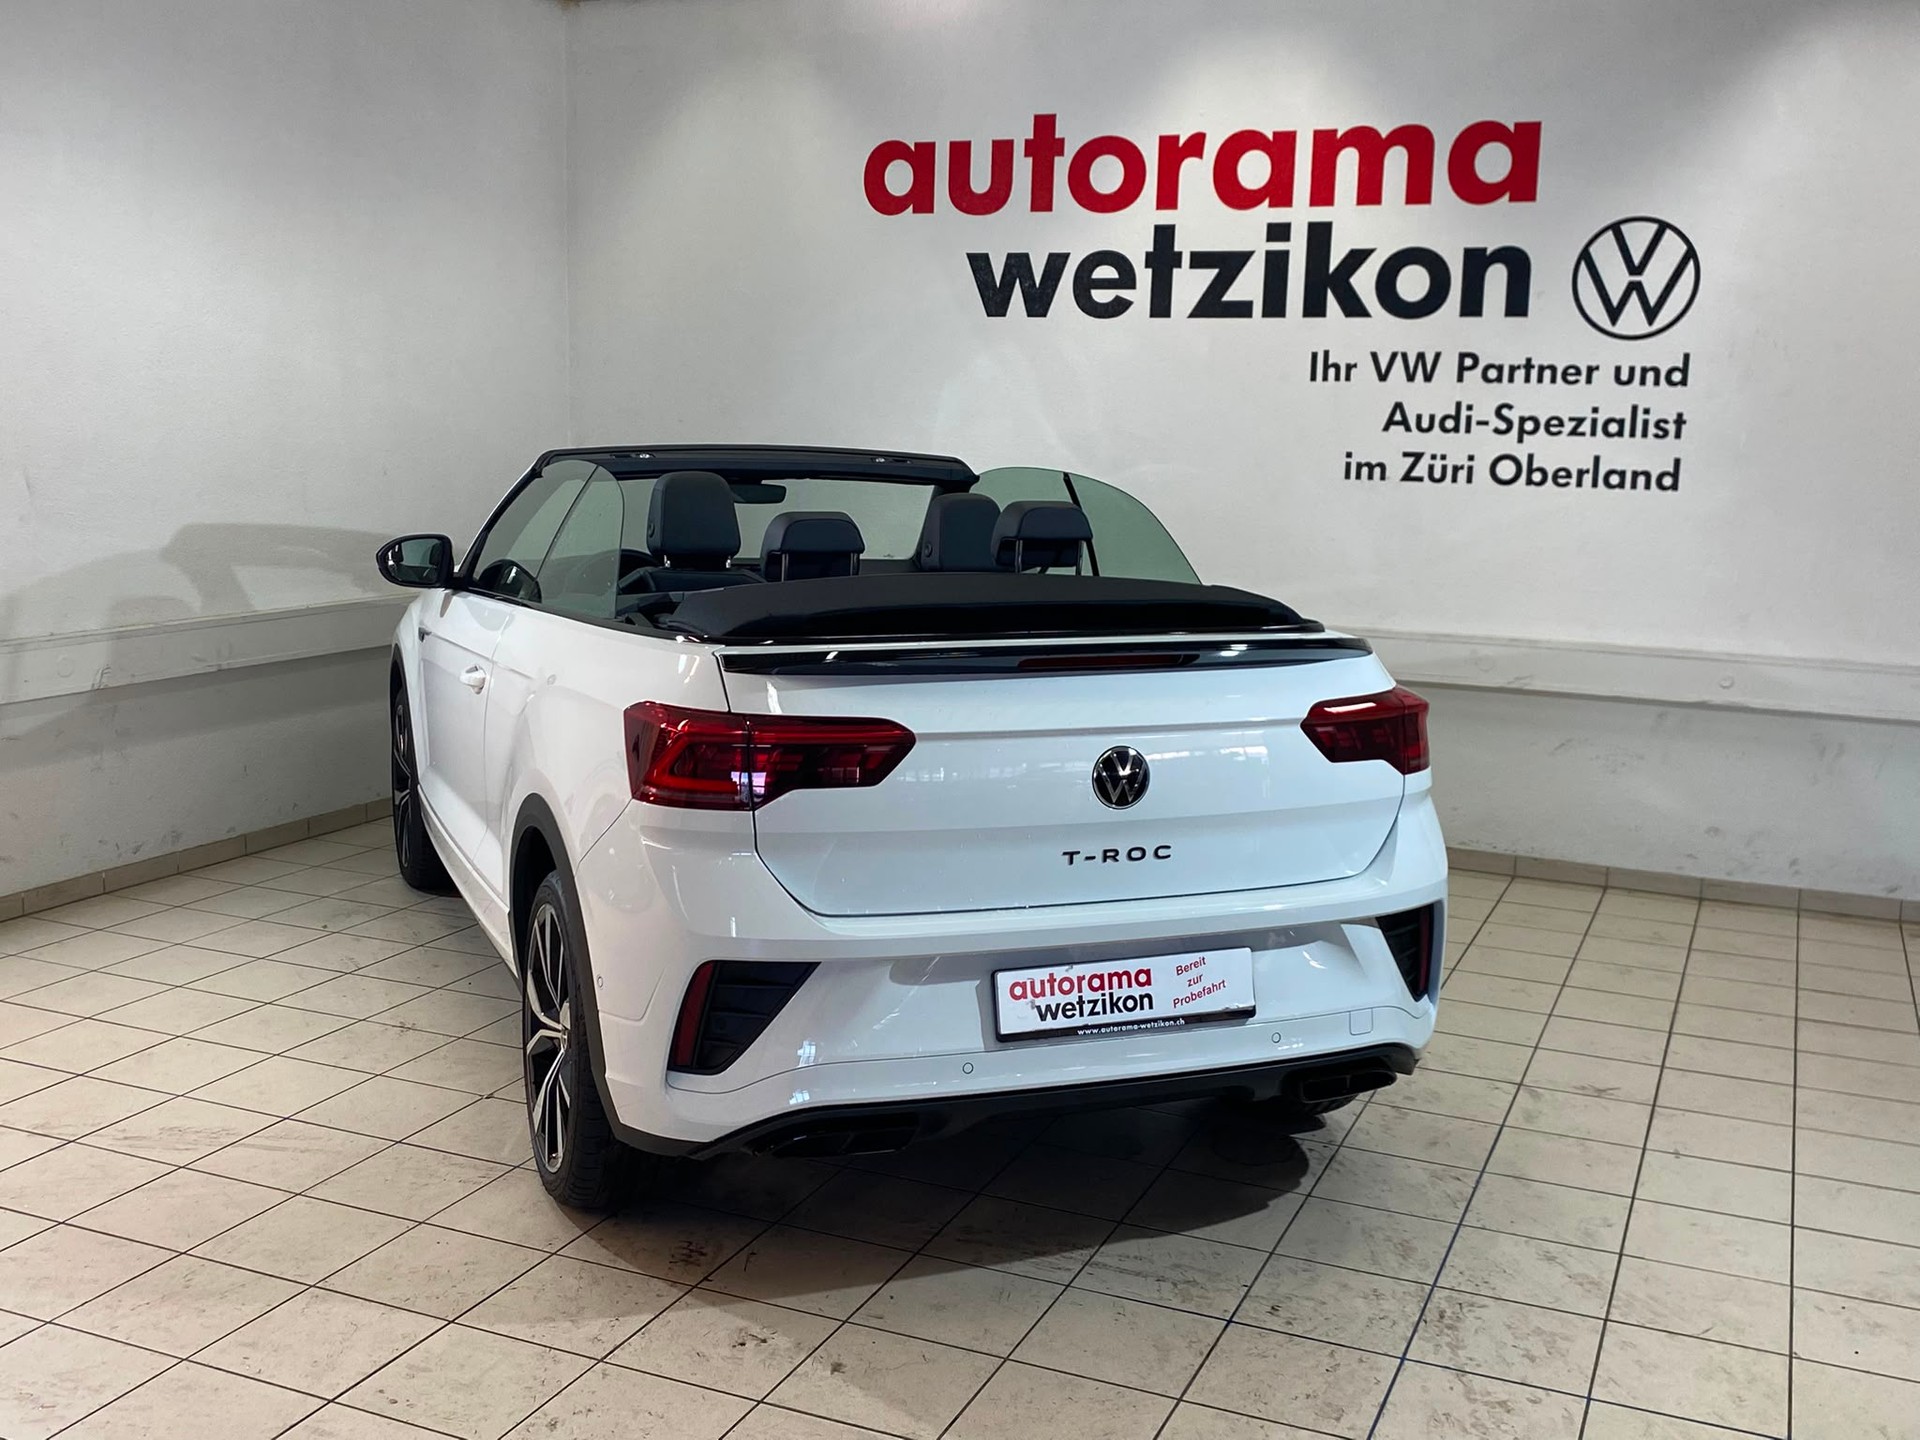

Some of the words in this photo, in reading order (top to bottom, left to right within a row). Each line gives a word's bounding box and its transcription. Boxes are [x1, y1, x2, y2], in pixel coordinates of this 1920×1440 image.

[863, 113, 1542, 216] autorama
[966, 221, 1532, 320] wetzikon
[1309, 350, 1358, 383] Ihr
[1370, 350, 1442, 383] VW
[1456, 351, 1600, 385] Partner
[1613, 352, 1691, 388] und
[1381, 401, 1688, 444] Audi-Spezialist
[1344, 451, 1388, 482] im
[1400, 451, 1476, 485] Züri
[1488, 452, 1682, 493] Oberland
[1061, 845, 1173, 866] T-ROC
[1175, 956, 1206, 976] Bereit
[1186, 972, 1204, 988] zur
[1009, 967, 1151, 1001] autorama
[1172, 979, 1226, 1008] Probefahrt
[1036, 991, 1153, 1022] wetzikon
[1077, 1018, 1185, 1035] www.autorama-wetzikon.ch
